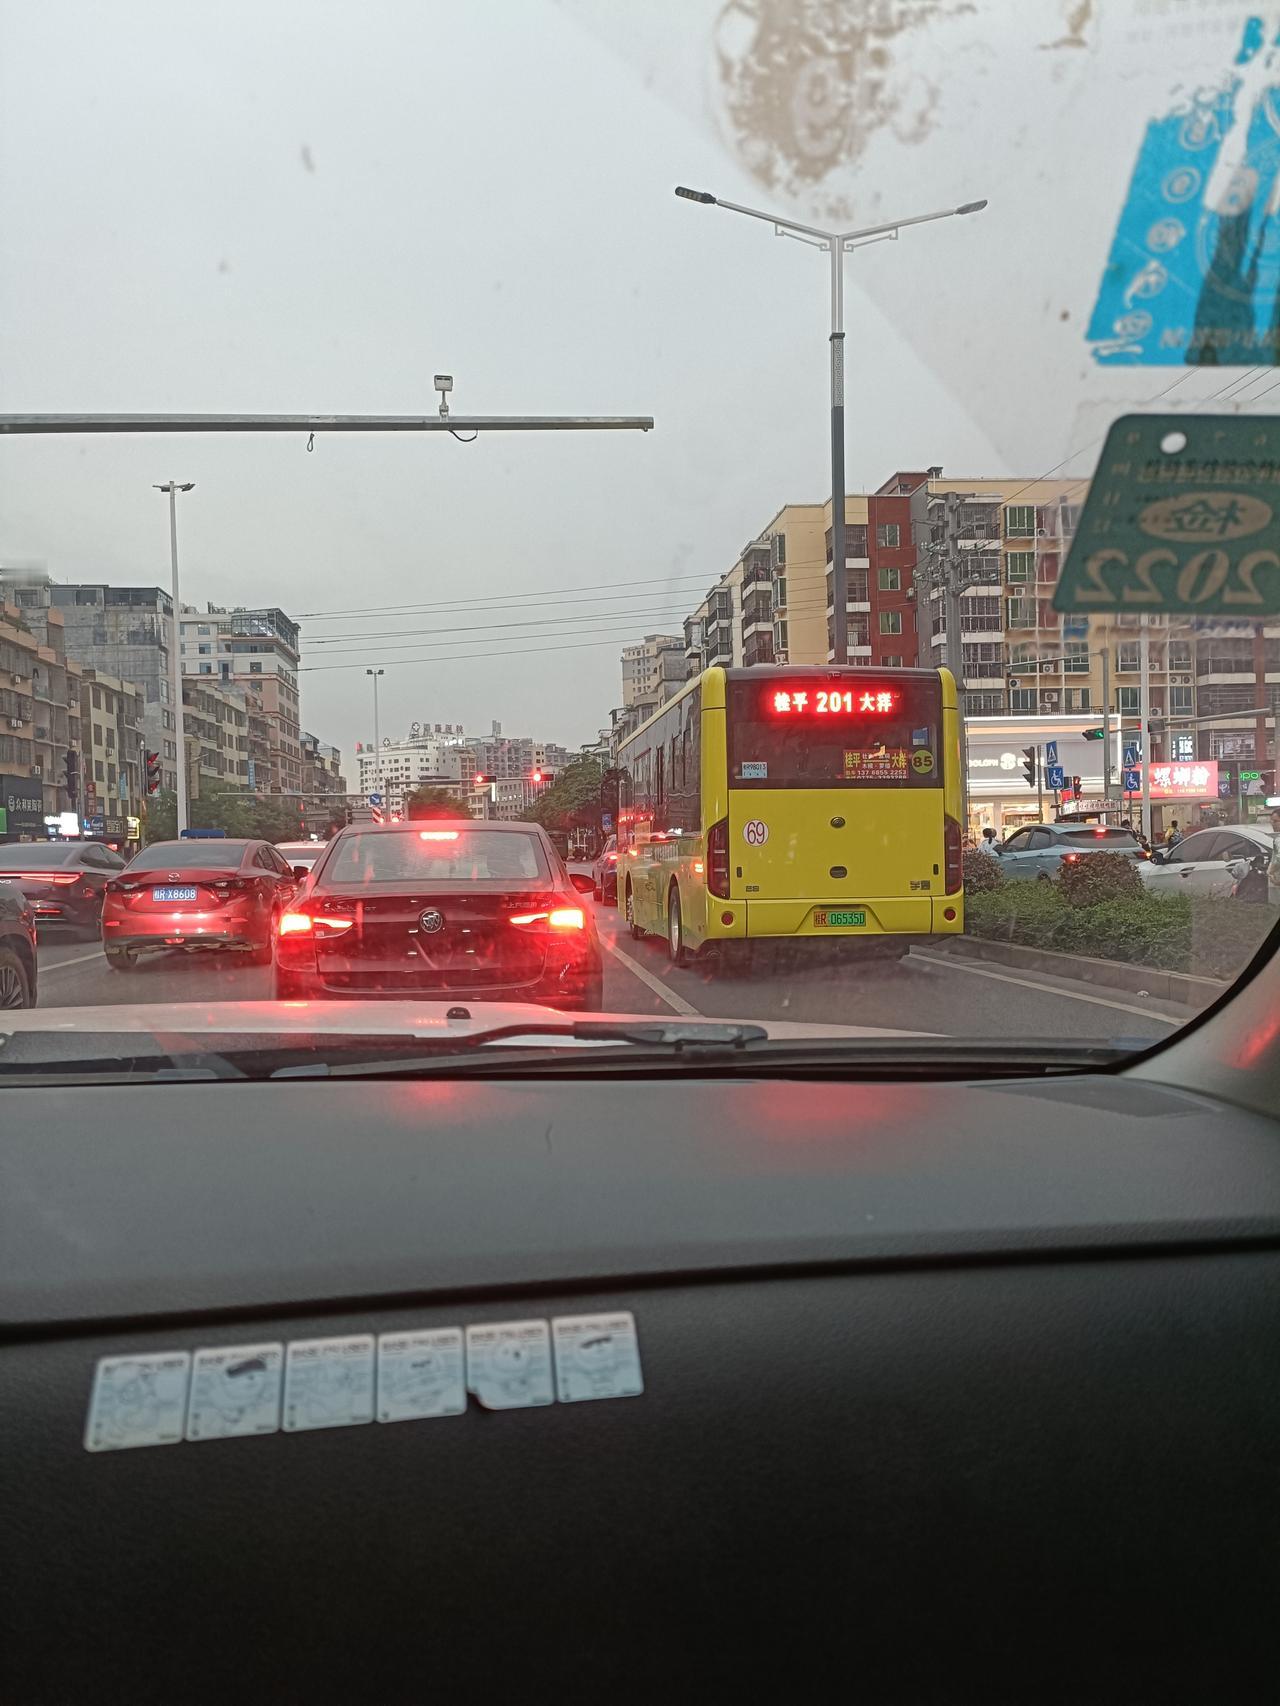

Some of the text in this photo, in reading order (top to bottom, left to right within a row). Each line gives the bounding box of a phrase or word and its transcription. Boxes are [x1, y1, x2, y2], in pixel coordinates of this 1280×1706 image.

[774, 692, 893, 712] 桂平 201 大洋
[845, 752, 861, 768] 桂平
[913, 755, 933, 768] 85
[1140, 765, 1211, 788] 螺蛳粉
[1225, 771, 1259, 781] po
[746, 821, 766, 844] 69
